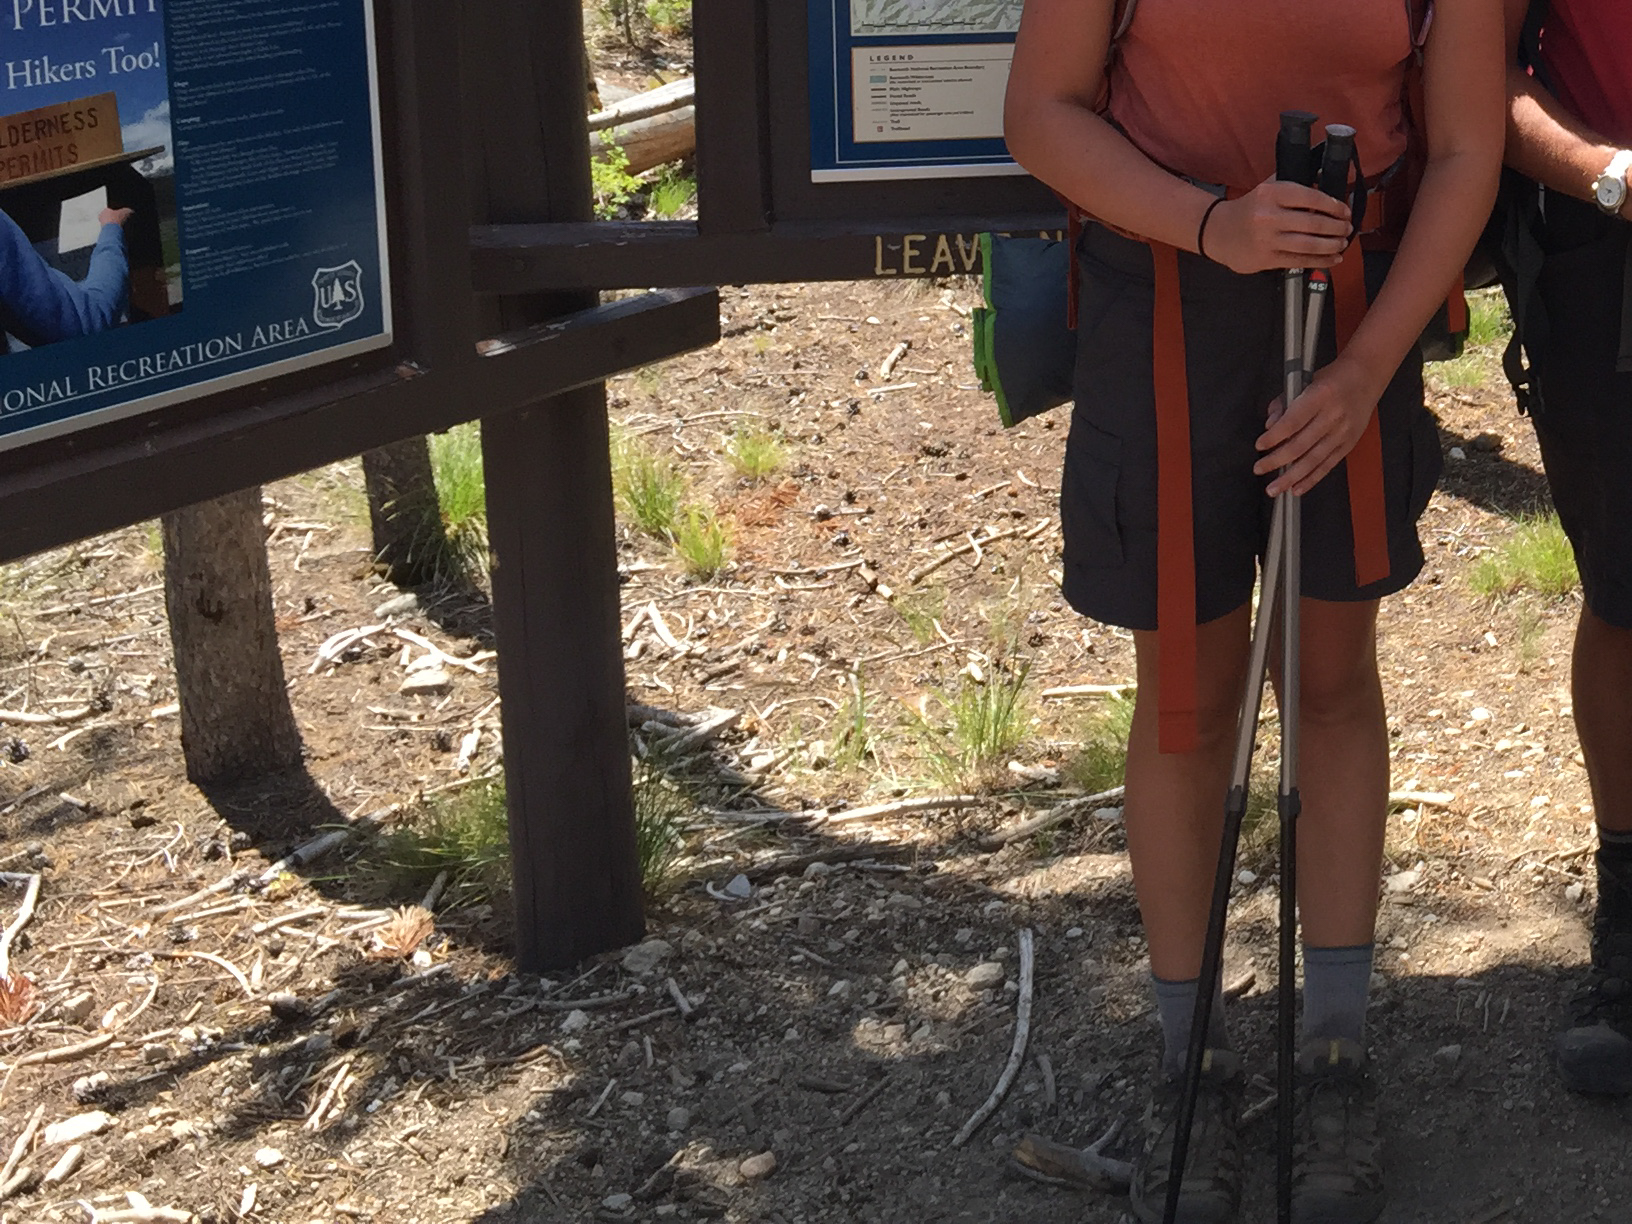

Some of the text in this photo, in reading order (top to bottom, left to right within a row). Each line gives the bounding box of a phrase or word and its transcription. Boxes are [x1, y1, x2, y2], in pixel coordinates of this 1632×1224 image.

[5, 41, 161, 90] Hikers Too!
[869, 54, 915, 62] LEGEND
[874, 232, 983, 275] LEAV
[88, 331, 243, 391] RECREATION
[250, 316, 311, 349] AREA
